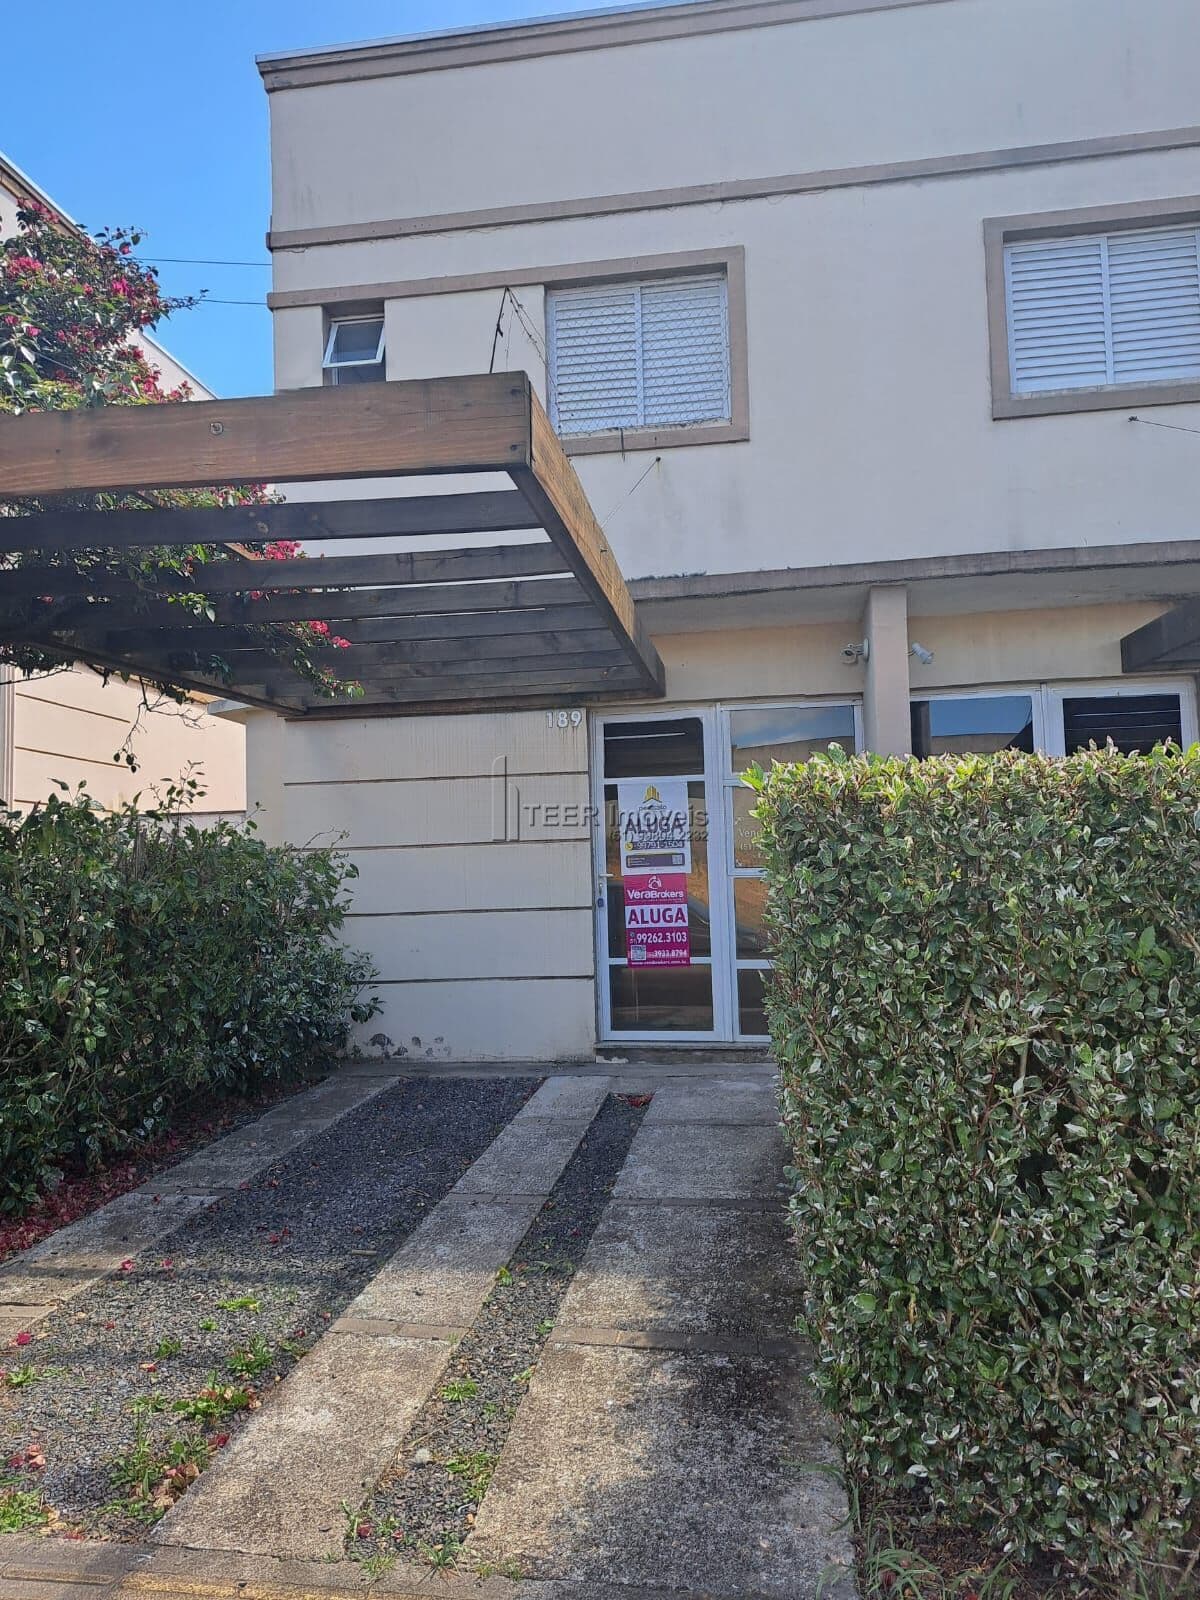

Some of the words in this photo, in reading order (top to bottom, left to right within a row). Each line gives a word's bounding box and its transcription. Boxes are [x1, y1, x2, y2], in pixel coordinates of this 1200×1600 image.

[546, 710, 582, 728] 189
[627, 889, 685, 899] VeraBrokers
[628, 907, 687, 925] ALUGA
[636, 932, 687, 944] 99262.3103
